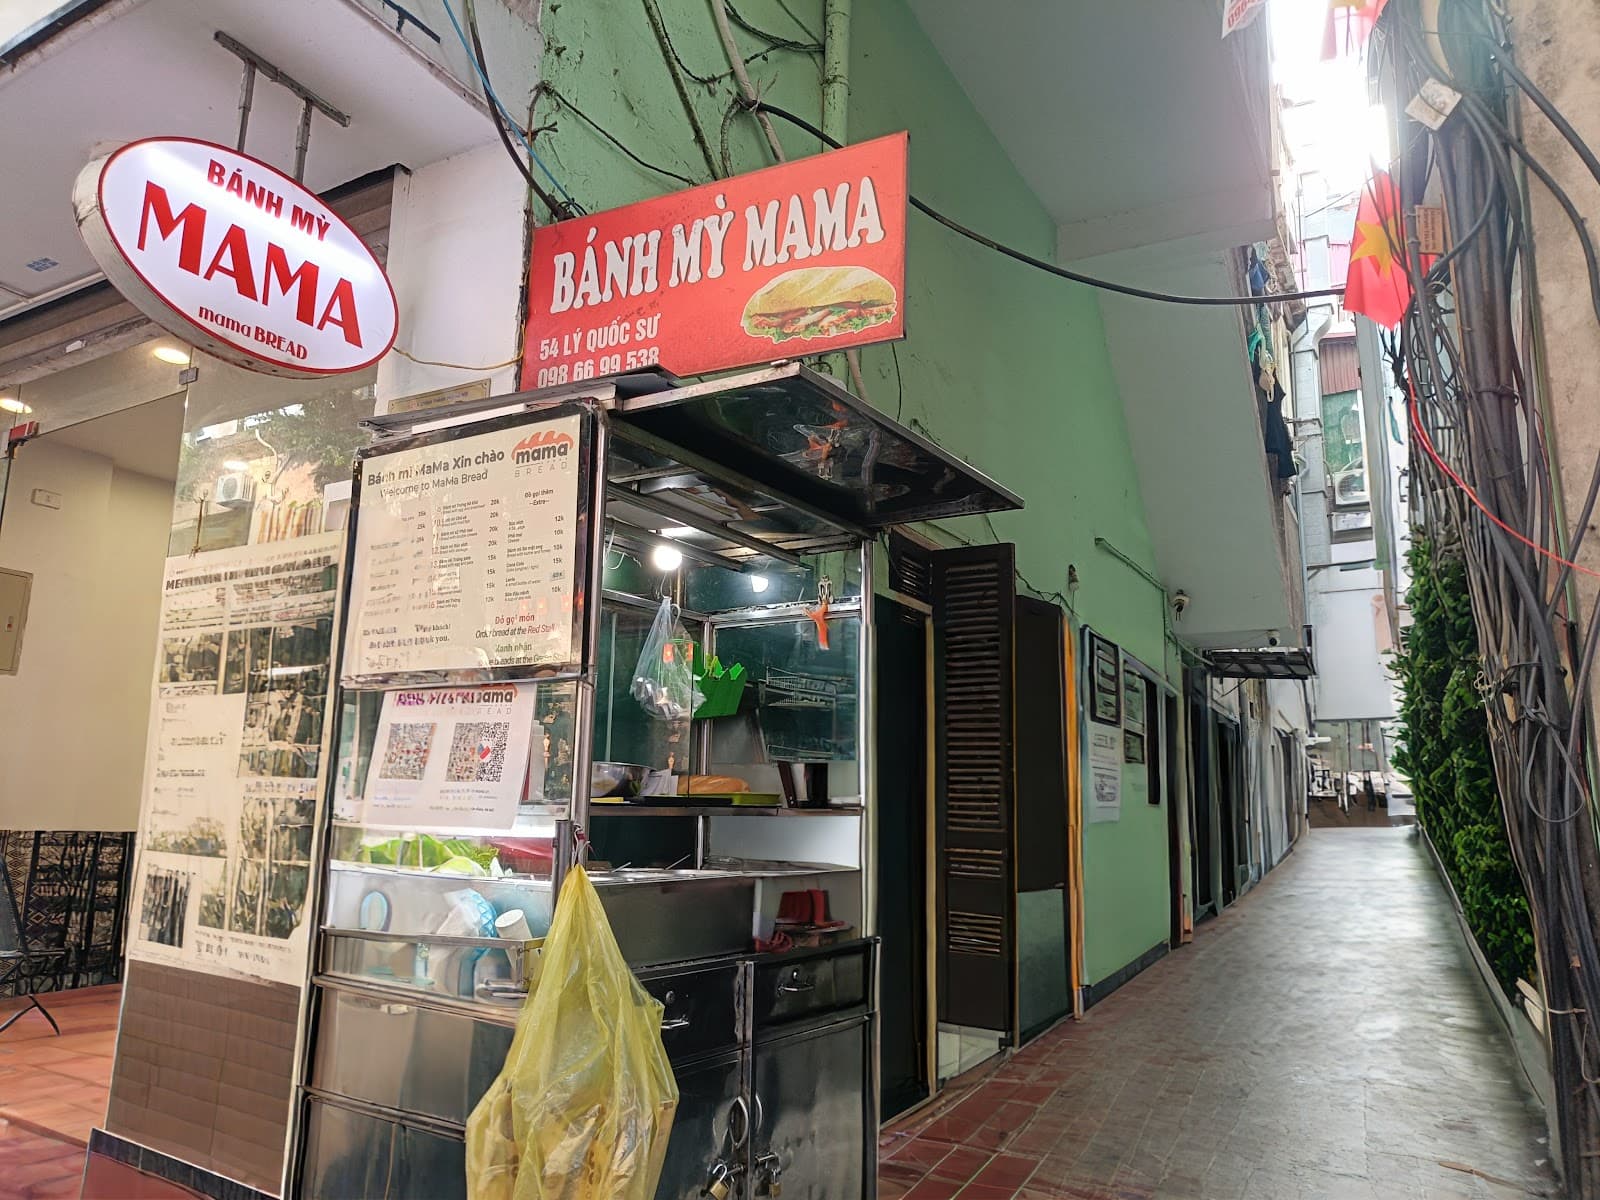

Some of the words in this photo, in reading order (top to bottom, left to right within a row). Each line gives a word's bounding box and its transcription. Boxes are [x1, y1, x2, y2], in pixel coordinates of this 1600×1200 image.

[207, 159, 284, 219] BÁNH
[291, 204, 331, 242] MỲ
[137, 180, 363, 348] MAMA
[550, 227, 662, 315] BÁNH
[669, 193, 735, 287] MỲ
[742, 176, 885, 272] MAMA
[199, 306, 251, 337] mama
[254, 326, 308, 360] BREAD
[540, 337, 559, 360] 54
[563, 328, 582, 356] LÝ
[586, 316, 630, 352] QUỐC
[635, 312, 661, 341] SƯ
[537, 364, 569, 388] 098
[573, 358, 594, 381] 66
[600, 353, 621, 376] 99
[626, 347, 659, 371] 538
[453, 456, 471, 470] Xin
[474, 449, 505, 465] chào
[515, 443, 568, 464] mama
[515, 461, 567, 478] BREAD
[380, 483, 419, 498] Welcome
[421, 481, 430, 491] to
[432, 475, 459, 489] MaMa
[461, 467, 488, 484] Bread
[516, 626, 527, 635] the
[528, 624, 540, 634] Red
